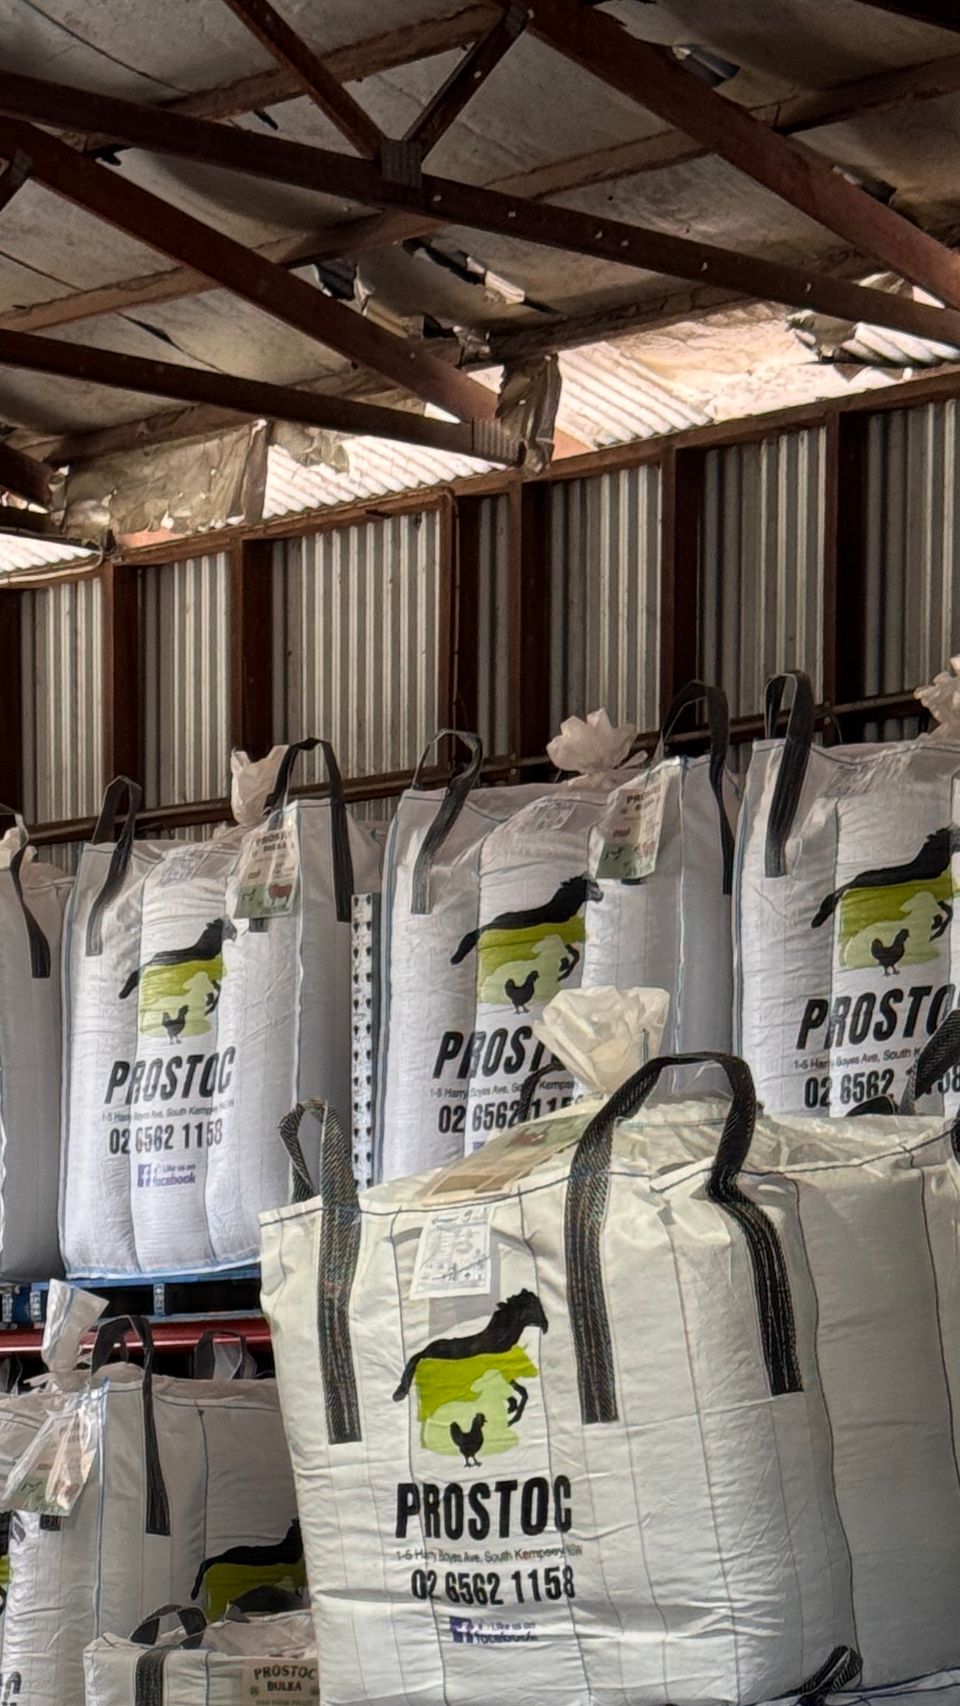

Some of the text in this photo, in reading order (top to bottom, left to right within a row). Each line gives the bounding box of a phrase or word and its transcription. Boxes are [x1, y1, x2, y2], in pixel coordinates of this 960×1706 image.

[796, 984, 960, 1050] PROSTO
[104, 1046, 236, 1105] PROSTOC
[804, 1077, 832, 1108] 02
[840, 1069, 894, 1105] 6562
[109, 1119, 223, 1154] 02 6562 1158
[438, 1105, 466, 1134] 02
[395, 1475, 572, 1540] PROSTOC
[484, 1550, 513, 1562] South
[411, 1565, 576, 1605] 02 6562 1158
[254, 1665, 318, 1680] PROSTOC
